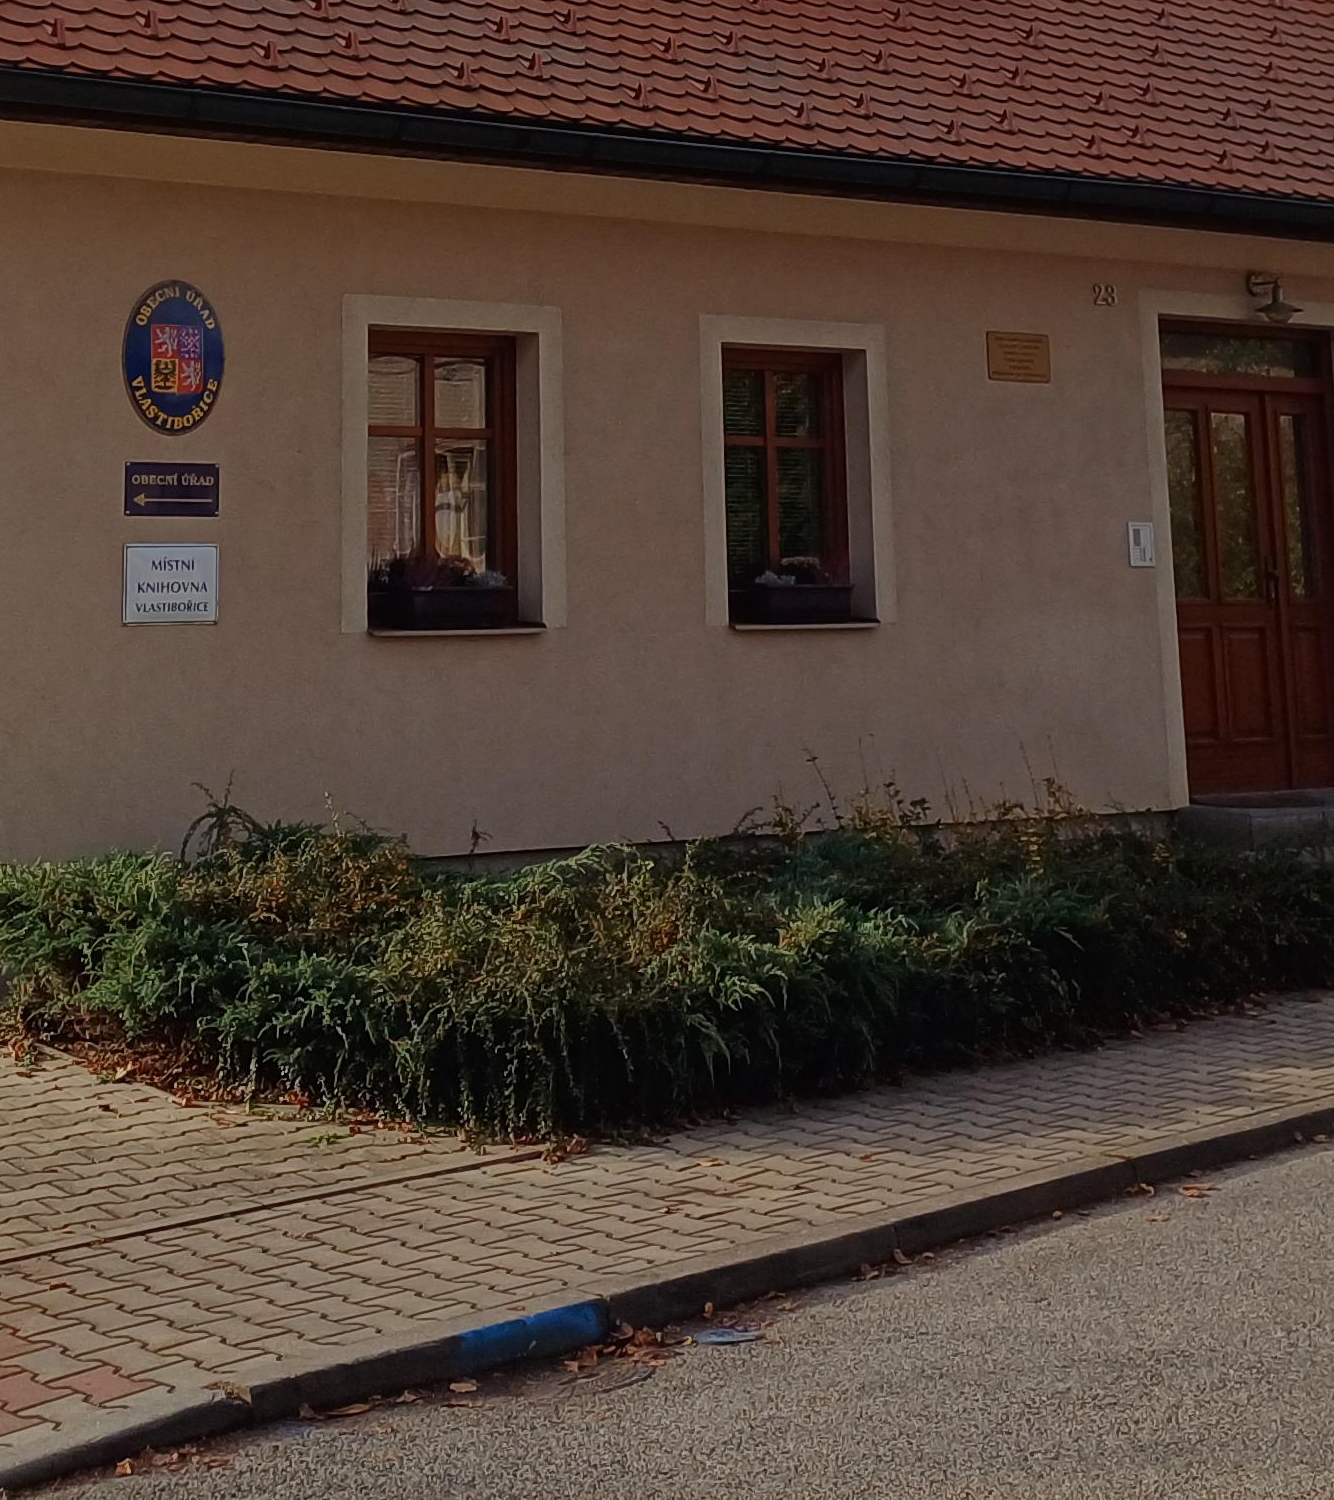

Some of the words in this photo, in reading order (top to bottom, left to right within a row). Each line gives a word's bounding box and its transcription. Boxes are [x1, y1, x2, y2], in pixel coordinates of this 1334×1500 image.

[1092, 283, 1118, 307] 28
[131, 375, 219, 430] VLASTIBOŘICE
[131, 472, 178, 486] OBECNÍ
[181, 472, 215, 486] ÚŘAD
[150, 556, 195, 572] MÍSTNÍ
[137, 580, 208, 595] KNIHOVNA
[135, 599, 209, 614] VLASTIBOŘICE
